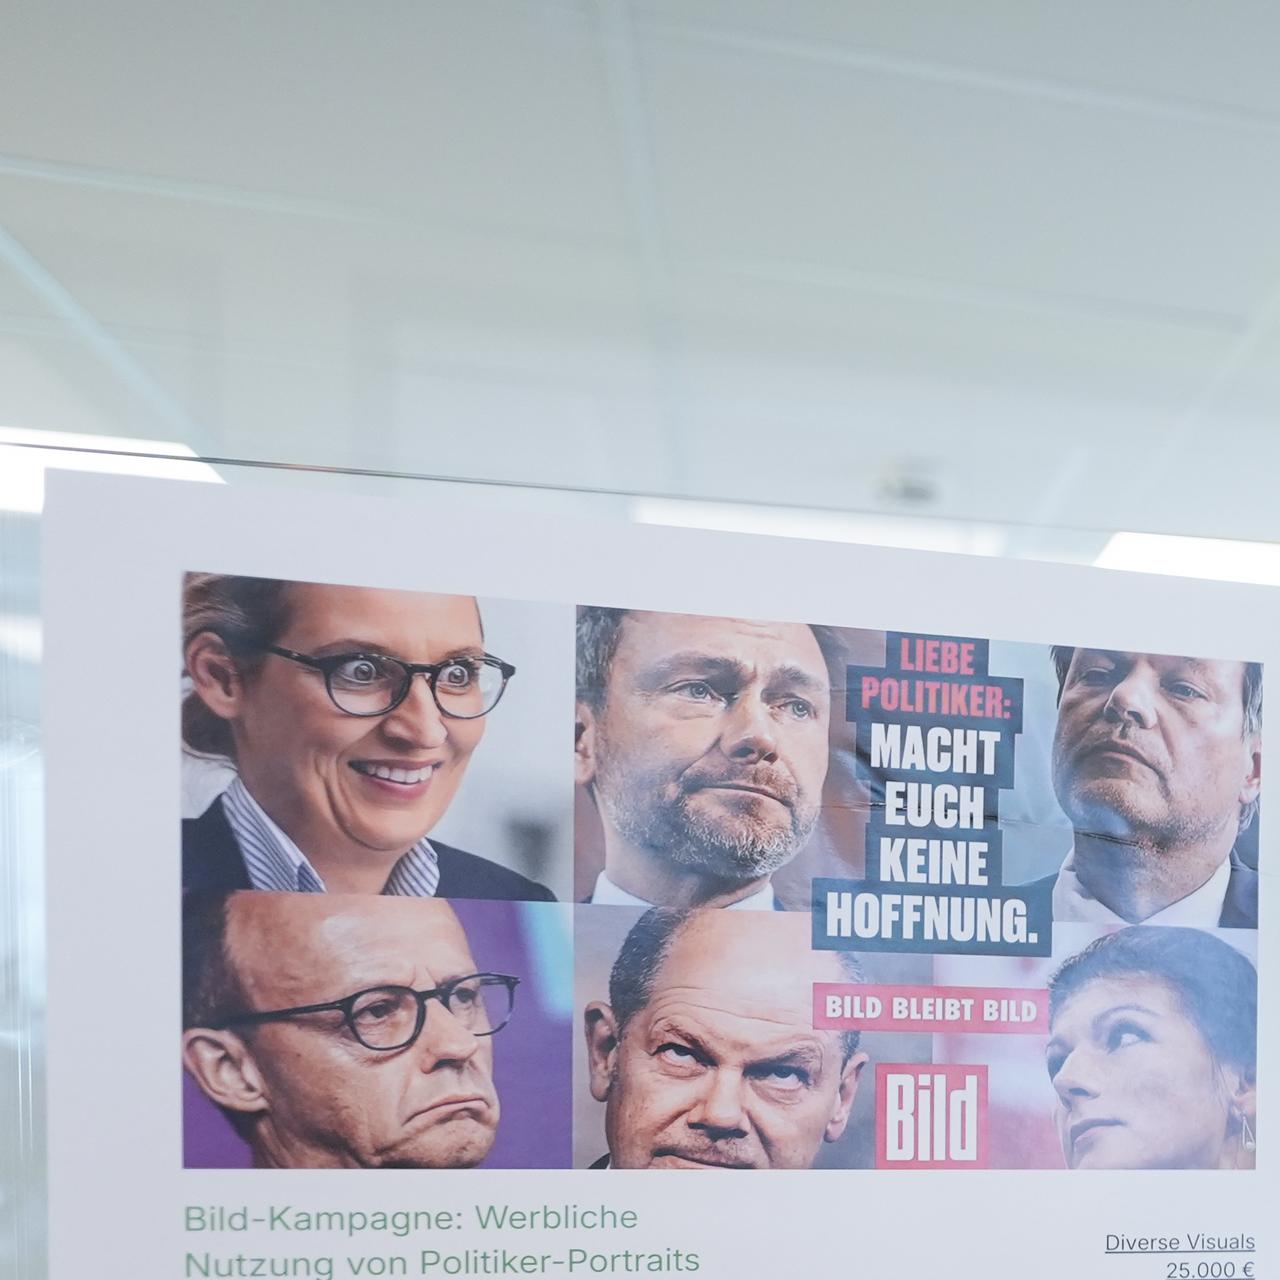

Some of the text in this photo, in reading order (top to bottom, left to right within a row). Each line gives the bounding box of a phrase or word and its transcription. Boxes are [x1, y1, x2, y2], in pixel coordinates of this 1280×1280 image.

[900, 637, 975, 675] LIEBE
[860, 676, 1012, 718] POLITIKER:
[870, 722, 1001, 775] MACHT
[885, 781, 985, 830] EUCH
[879, 837, 989, 886] KEINE
[826, 891, 1038, 944] HOFFNUNG.
[826, 995, 1037, 1023] BILD BLEIBT BILD
[886, 1074, 978, 1162] Bild
[184, 1204, 638, 1238] Bild-Kampagne: Werbliche
[346, 1256, 408, 1276] von
[421, 1247, 700, 1275] Politiker-Portraits
[1106, 1233, 1255, 1252] Diverse Visuals
[1166, 1261, 1255, 1280] 25.000 €
